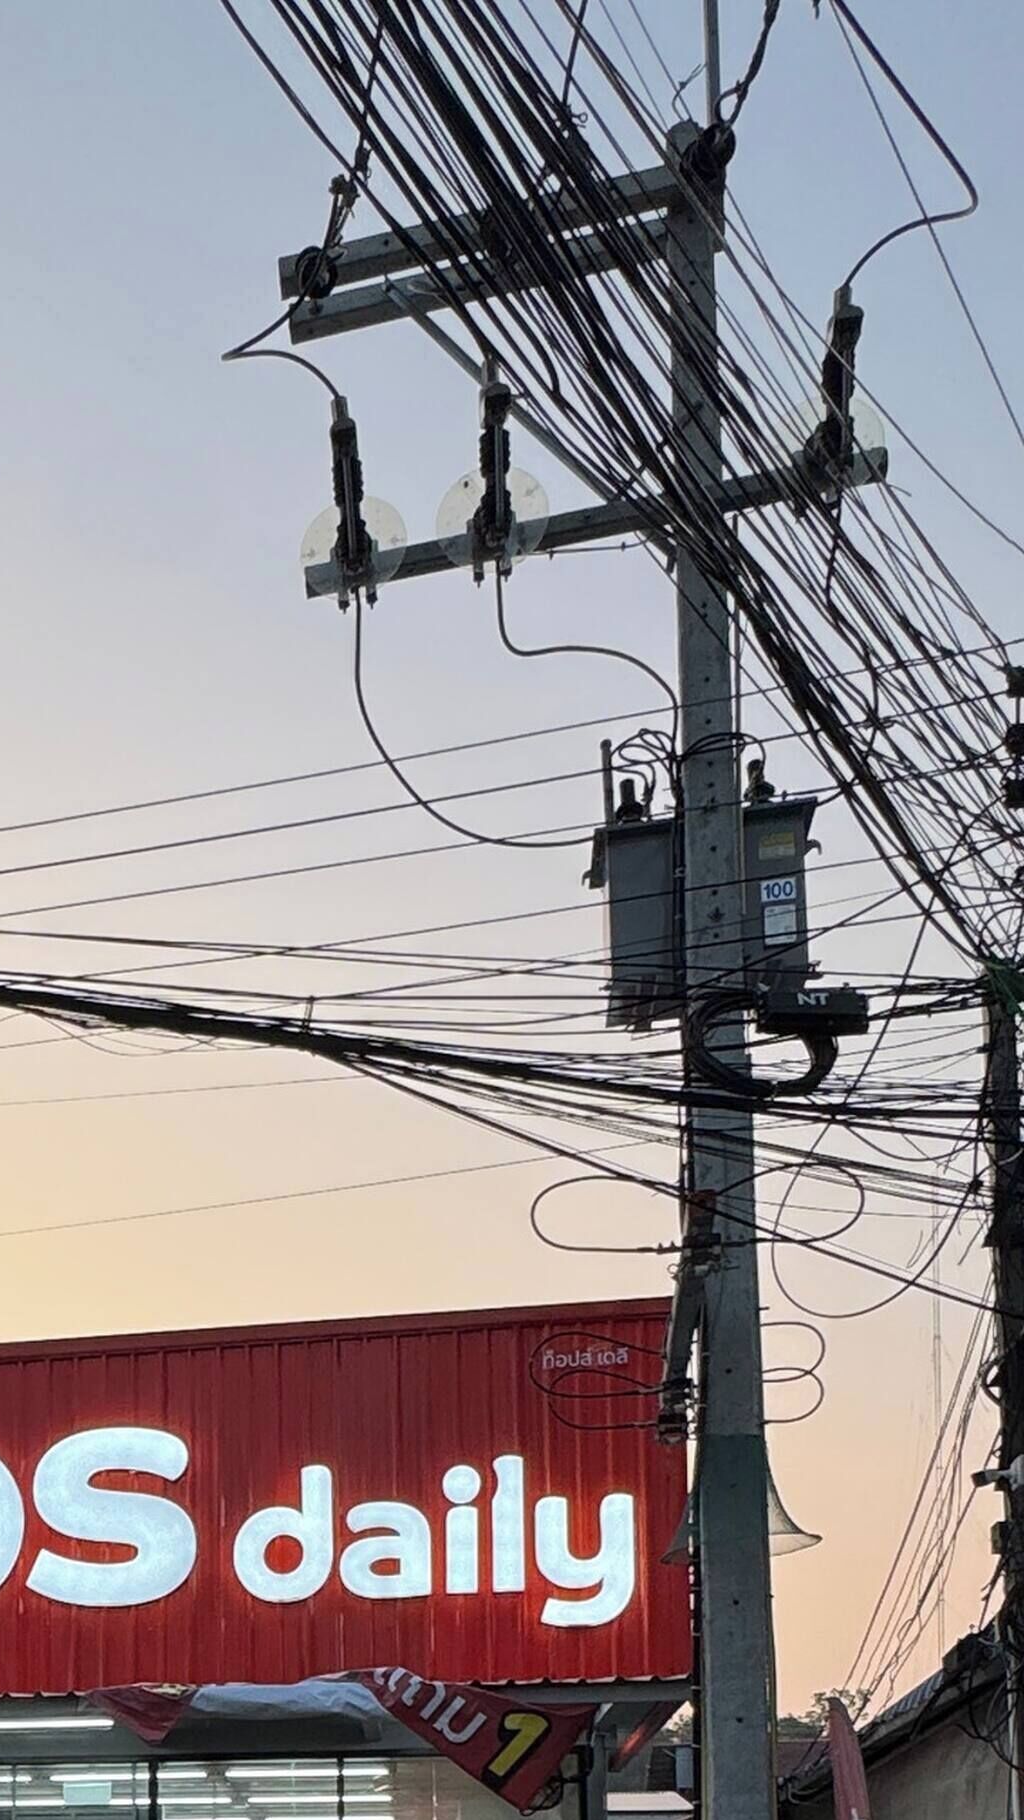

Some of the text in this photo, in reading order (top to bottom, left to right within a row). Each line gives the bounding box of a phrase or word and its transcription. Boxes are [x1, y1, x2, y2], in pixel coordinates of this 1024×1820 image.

[763, 880, 794, 899] 100
[797, 993, 829, 1006] NT
[233, 1454, 636, 1628] daily
[487, 1712, 550, 1777] 1
